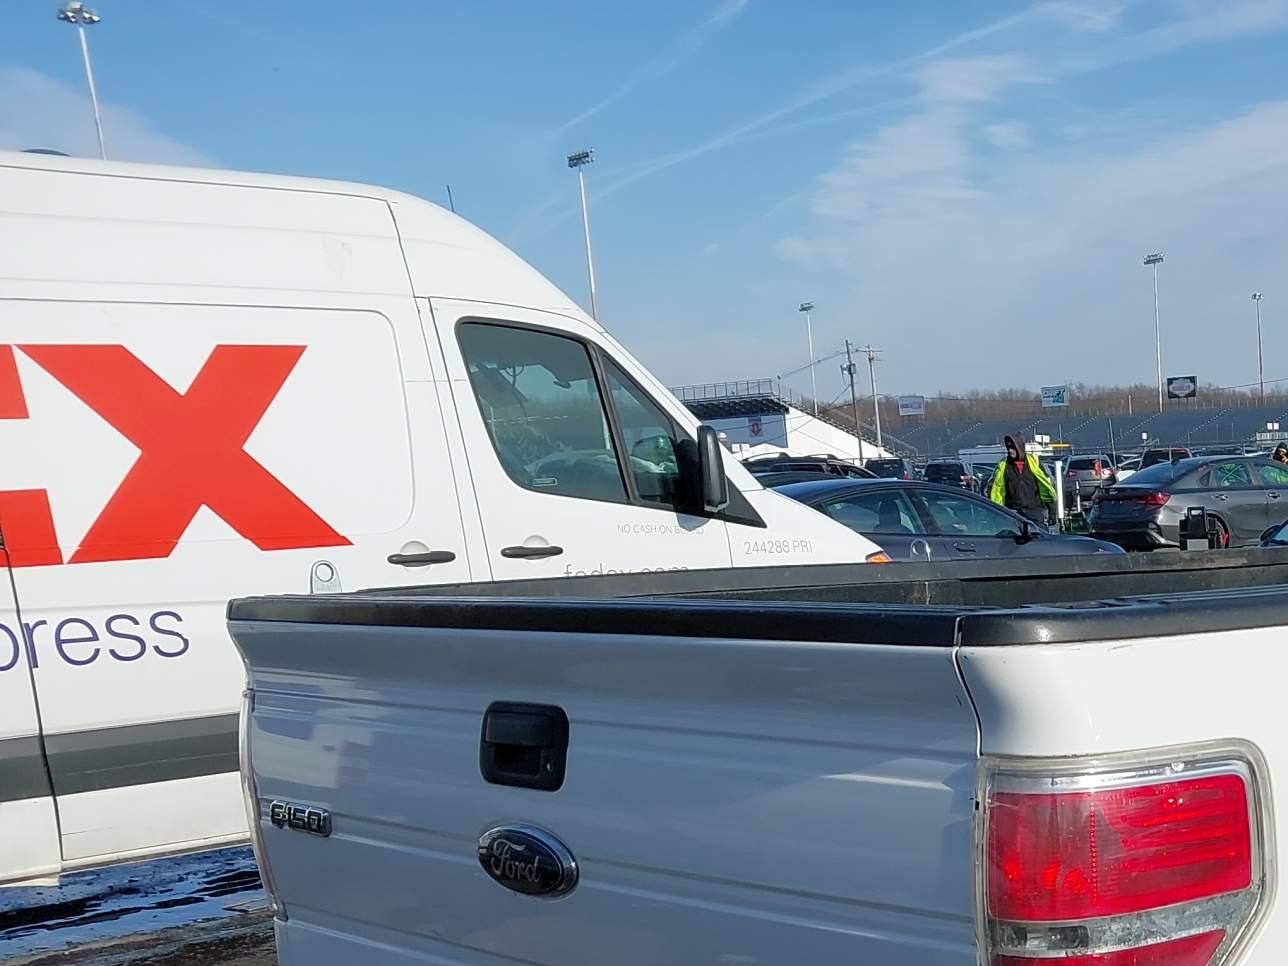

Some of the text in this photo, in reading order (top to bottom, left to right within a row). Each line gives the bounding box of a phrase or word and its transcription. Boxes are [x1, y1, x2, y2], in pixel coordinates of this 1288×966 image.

[617, 523, 631, 534] NO
[633, 524, 657, 535] CASH
[659, 524, 673, 535] ON
[743, 539, 814, 555] 244288 PRI
[490, 838, 541, 883] Ford
